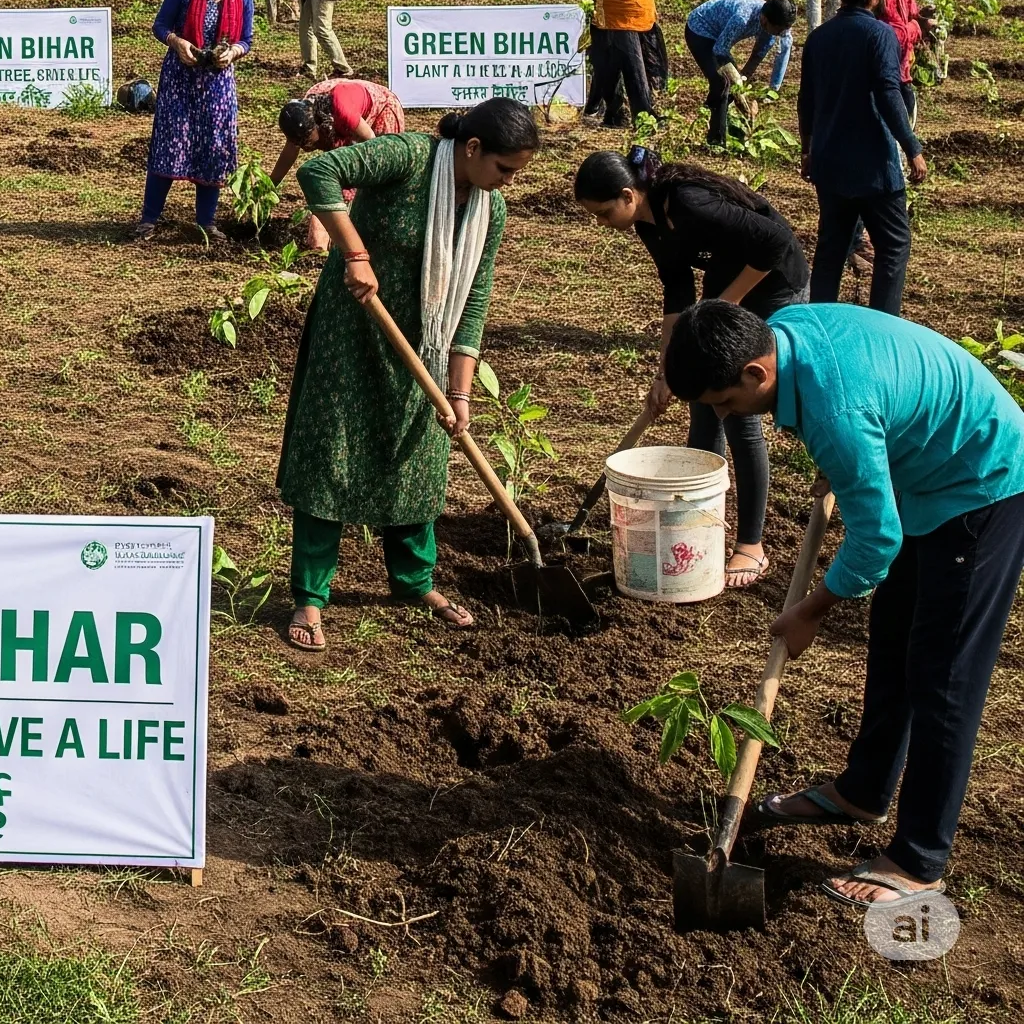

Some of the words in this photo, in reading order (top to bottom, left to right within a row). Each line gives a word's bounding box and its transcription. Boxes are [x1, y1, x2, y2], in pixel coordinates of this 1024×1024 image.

[21, 36, 95, 59] BIHAR
[404, 32, 486, 56] GREEN
[493, 31, 570, 55] BIHAR
[406, 64, 449, 78] PLANT
[55, 717, 85, 760] A
[99, 719, 186, 762] LIFE
